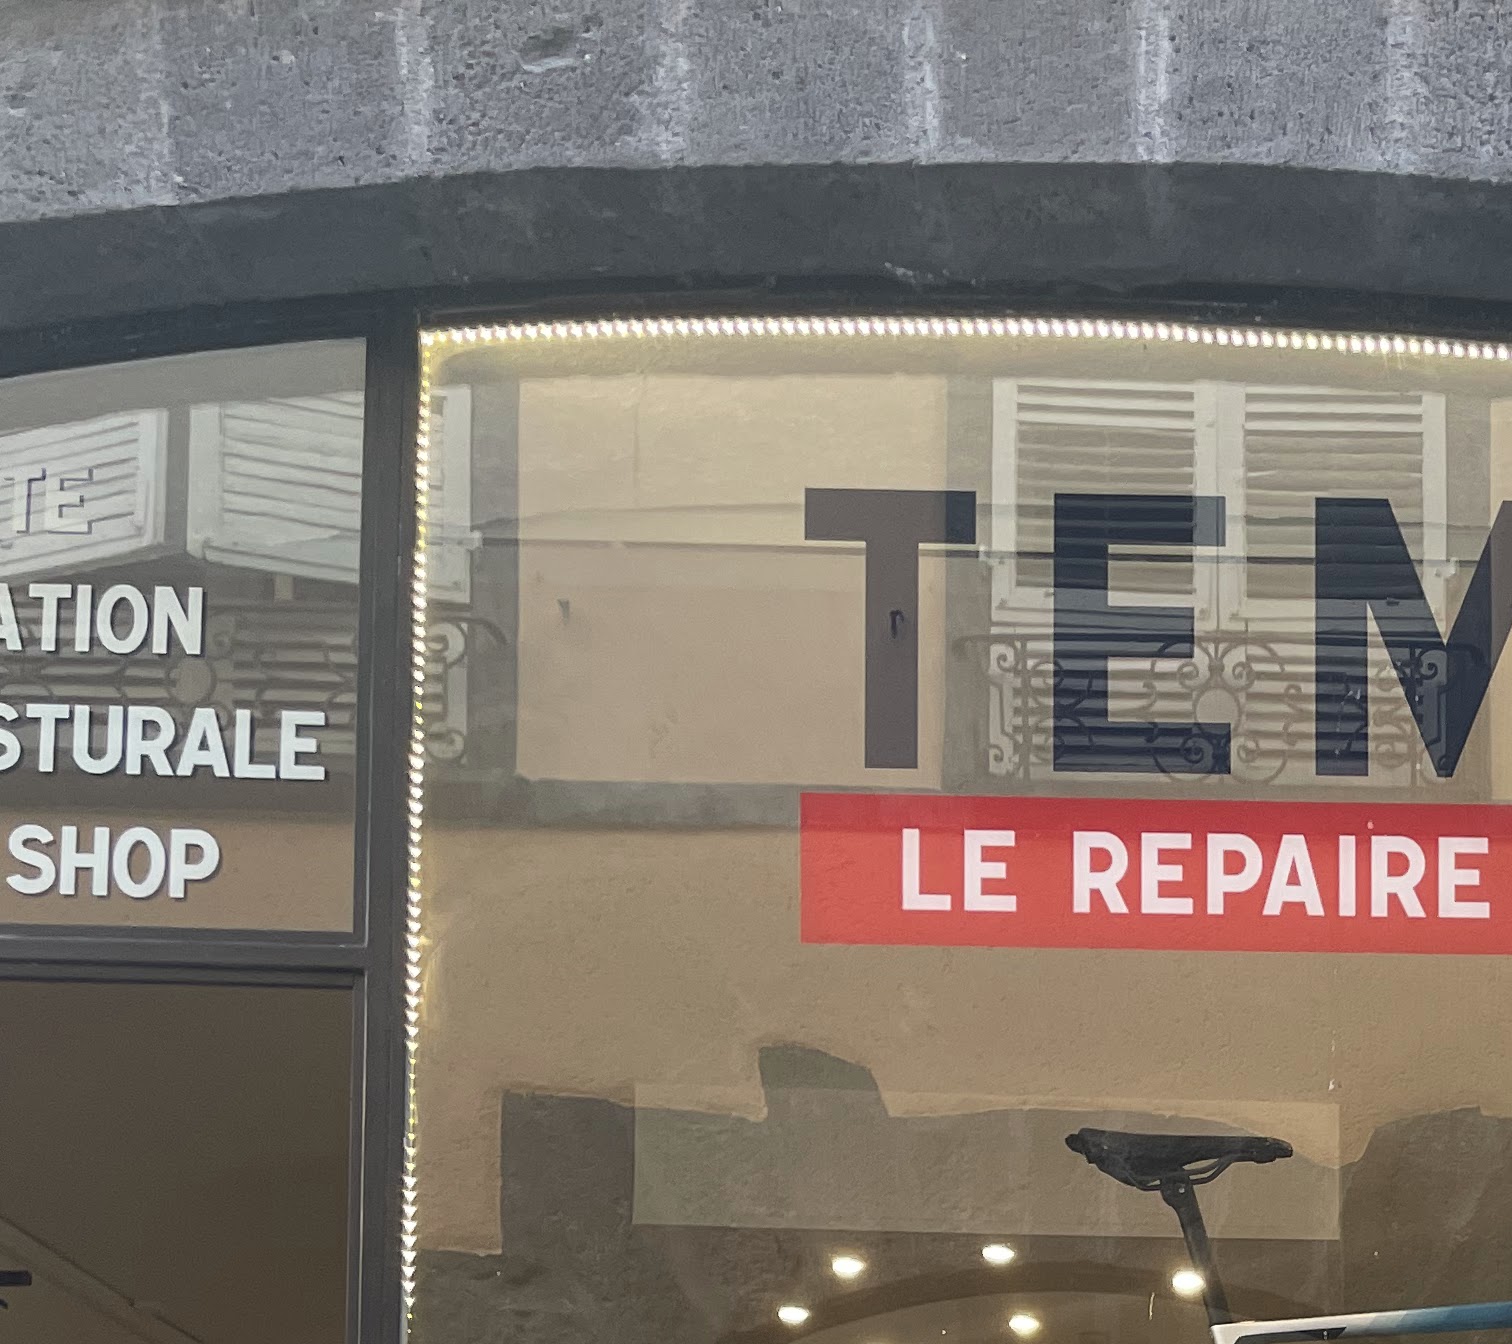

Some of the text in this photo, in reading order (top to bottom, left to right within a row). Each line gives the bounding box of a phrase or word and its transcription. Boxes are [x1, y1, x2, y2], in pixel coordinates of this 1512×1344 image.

[5, 823, 220, 899] SHOP
[901, 828, 1017, 911] LE
[1072, 831, 1491, 919] REPAIRE
